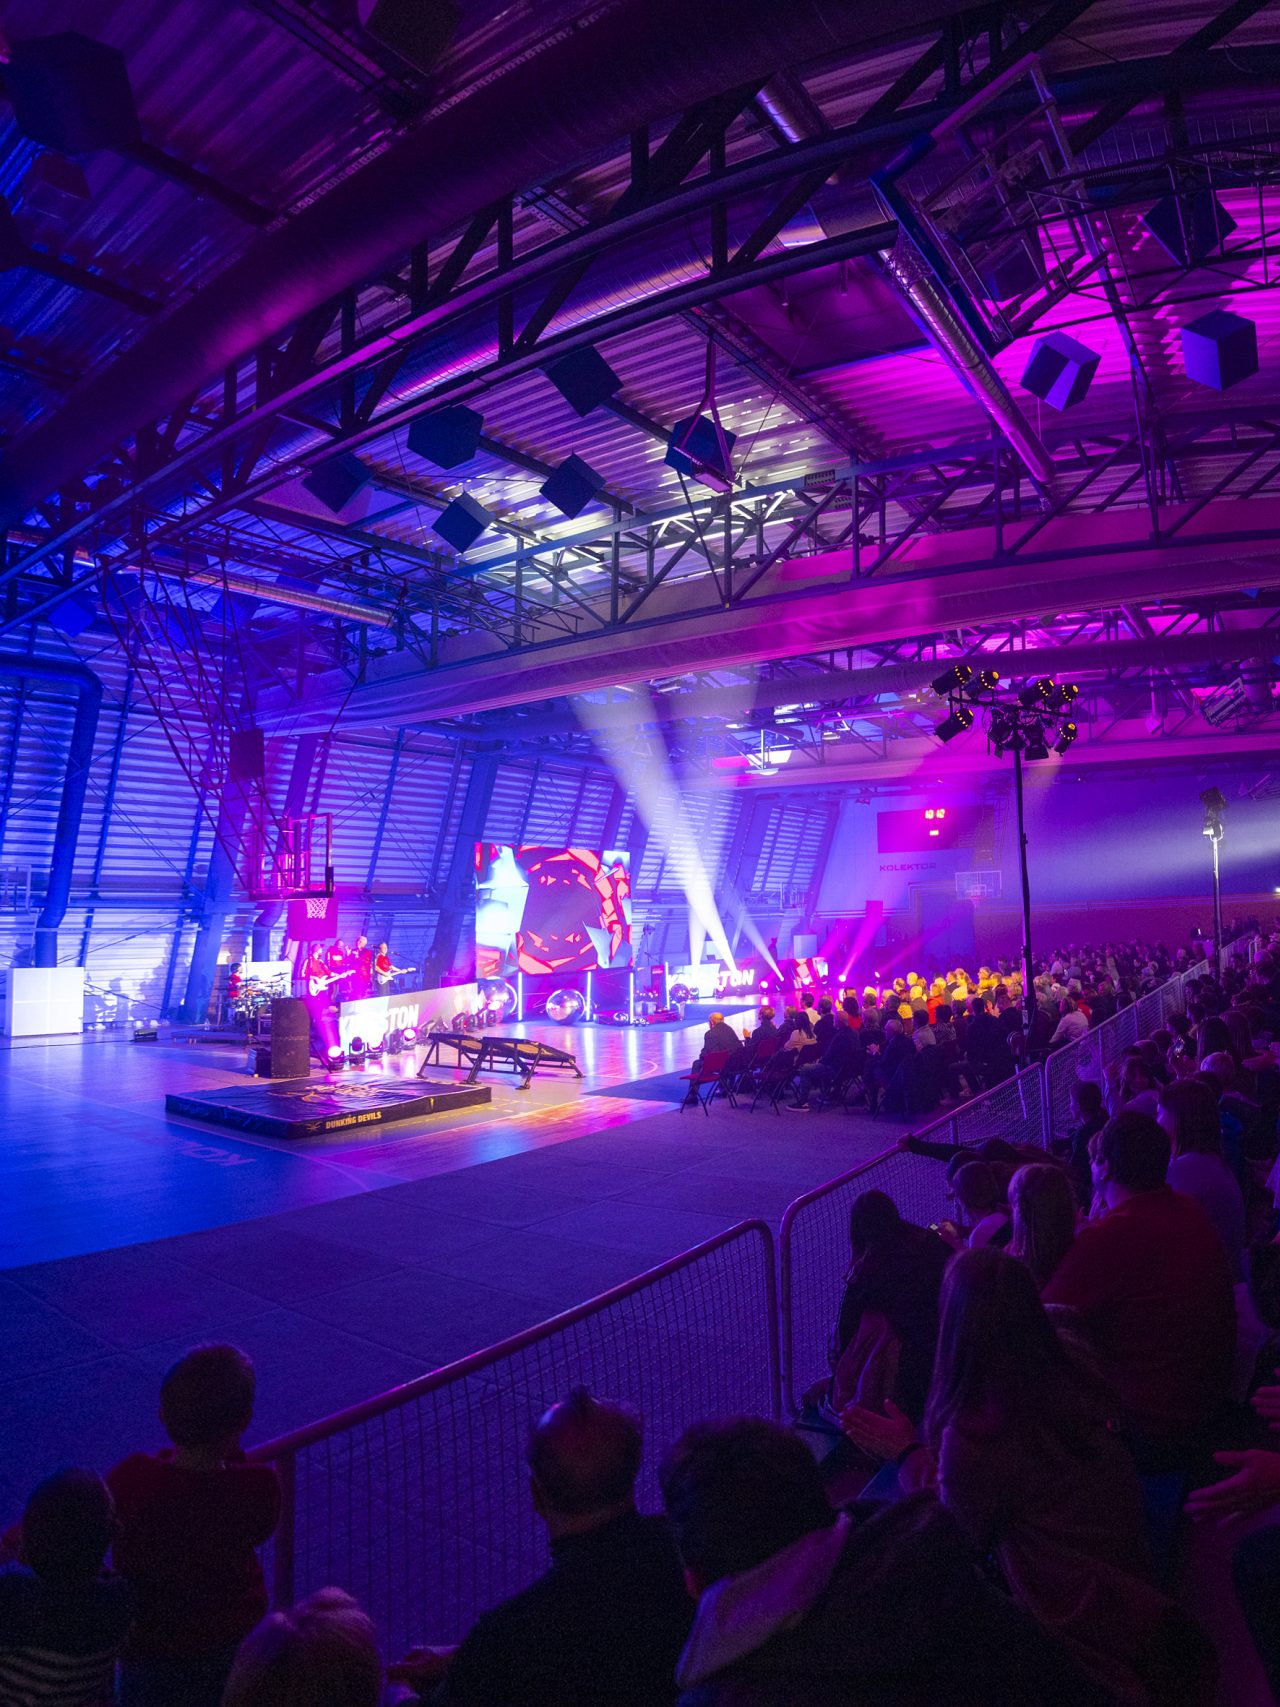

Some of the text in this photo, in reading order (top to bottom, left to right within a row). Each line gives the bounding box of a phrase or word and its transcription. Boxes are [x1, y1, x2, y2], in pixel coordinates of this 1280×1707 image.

[880, 863, 937, 872] KOLEKTOR
[668, 969, 755, 990] KSTON
[339, 1004, 420, 1040] KSTON
[325, 1111, 382, 1129] DUNKING DEVILS
